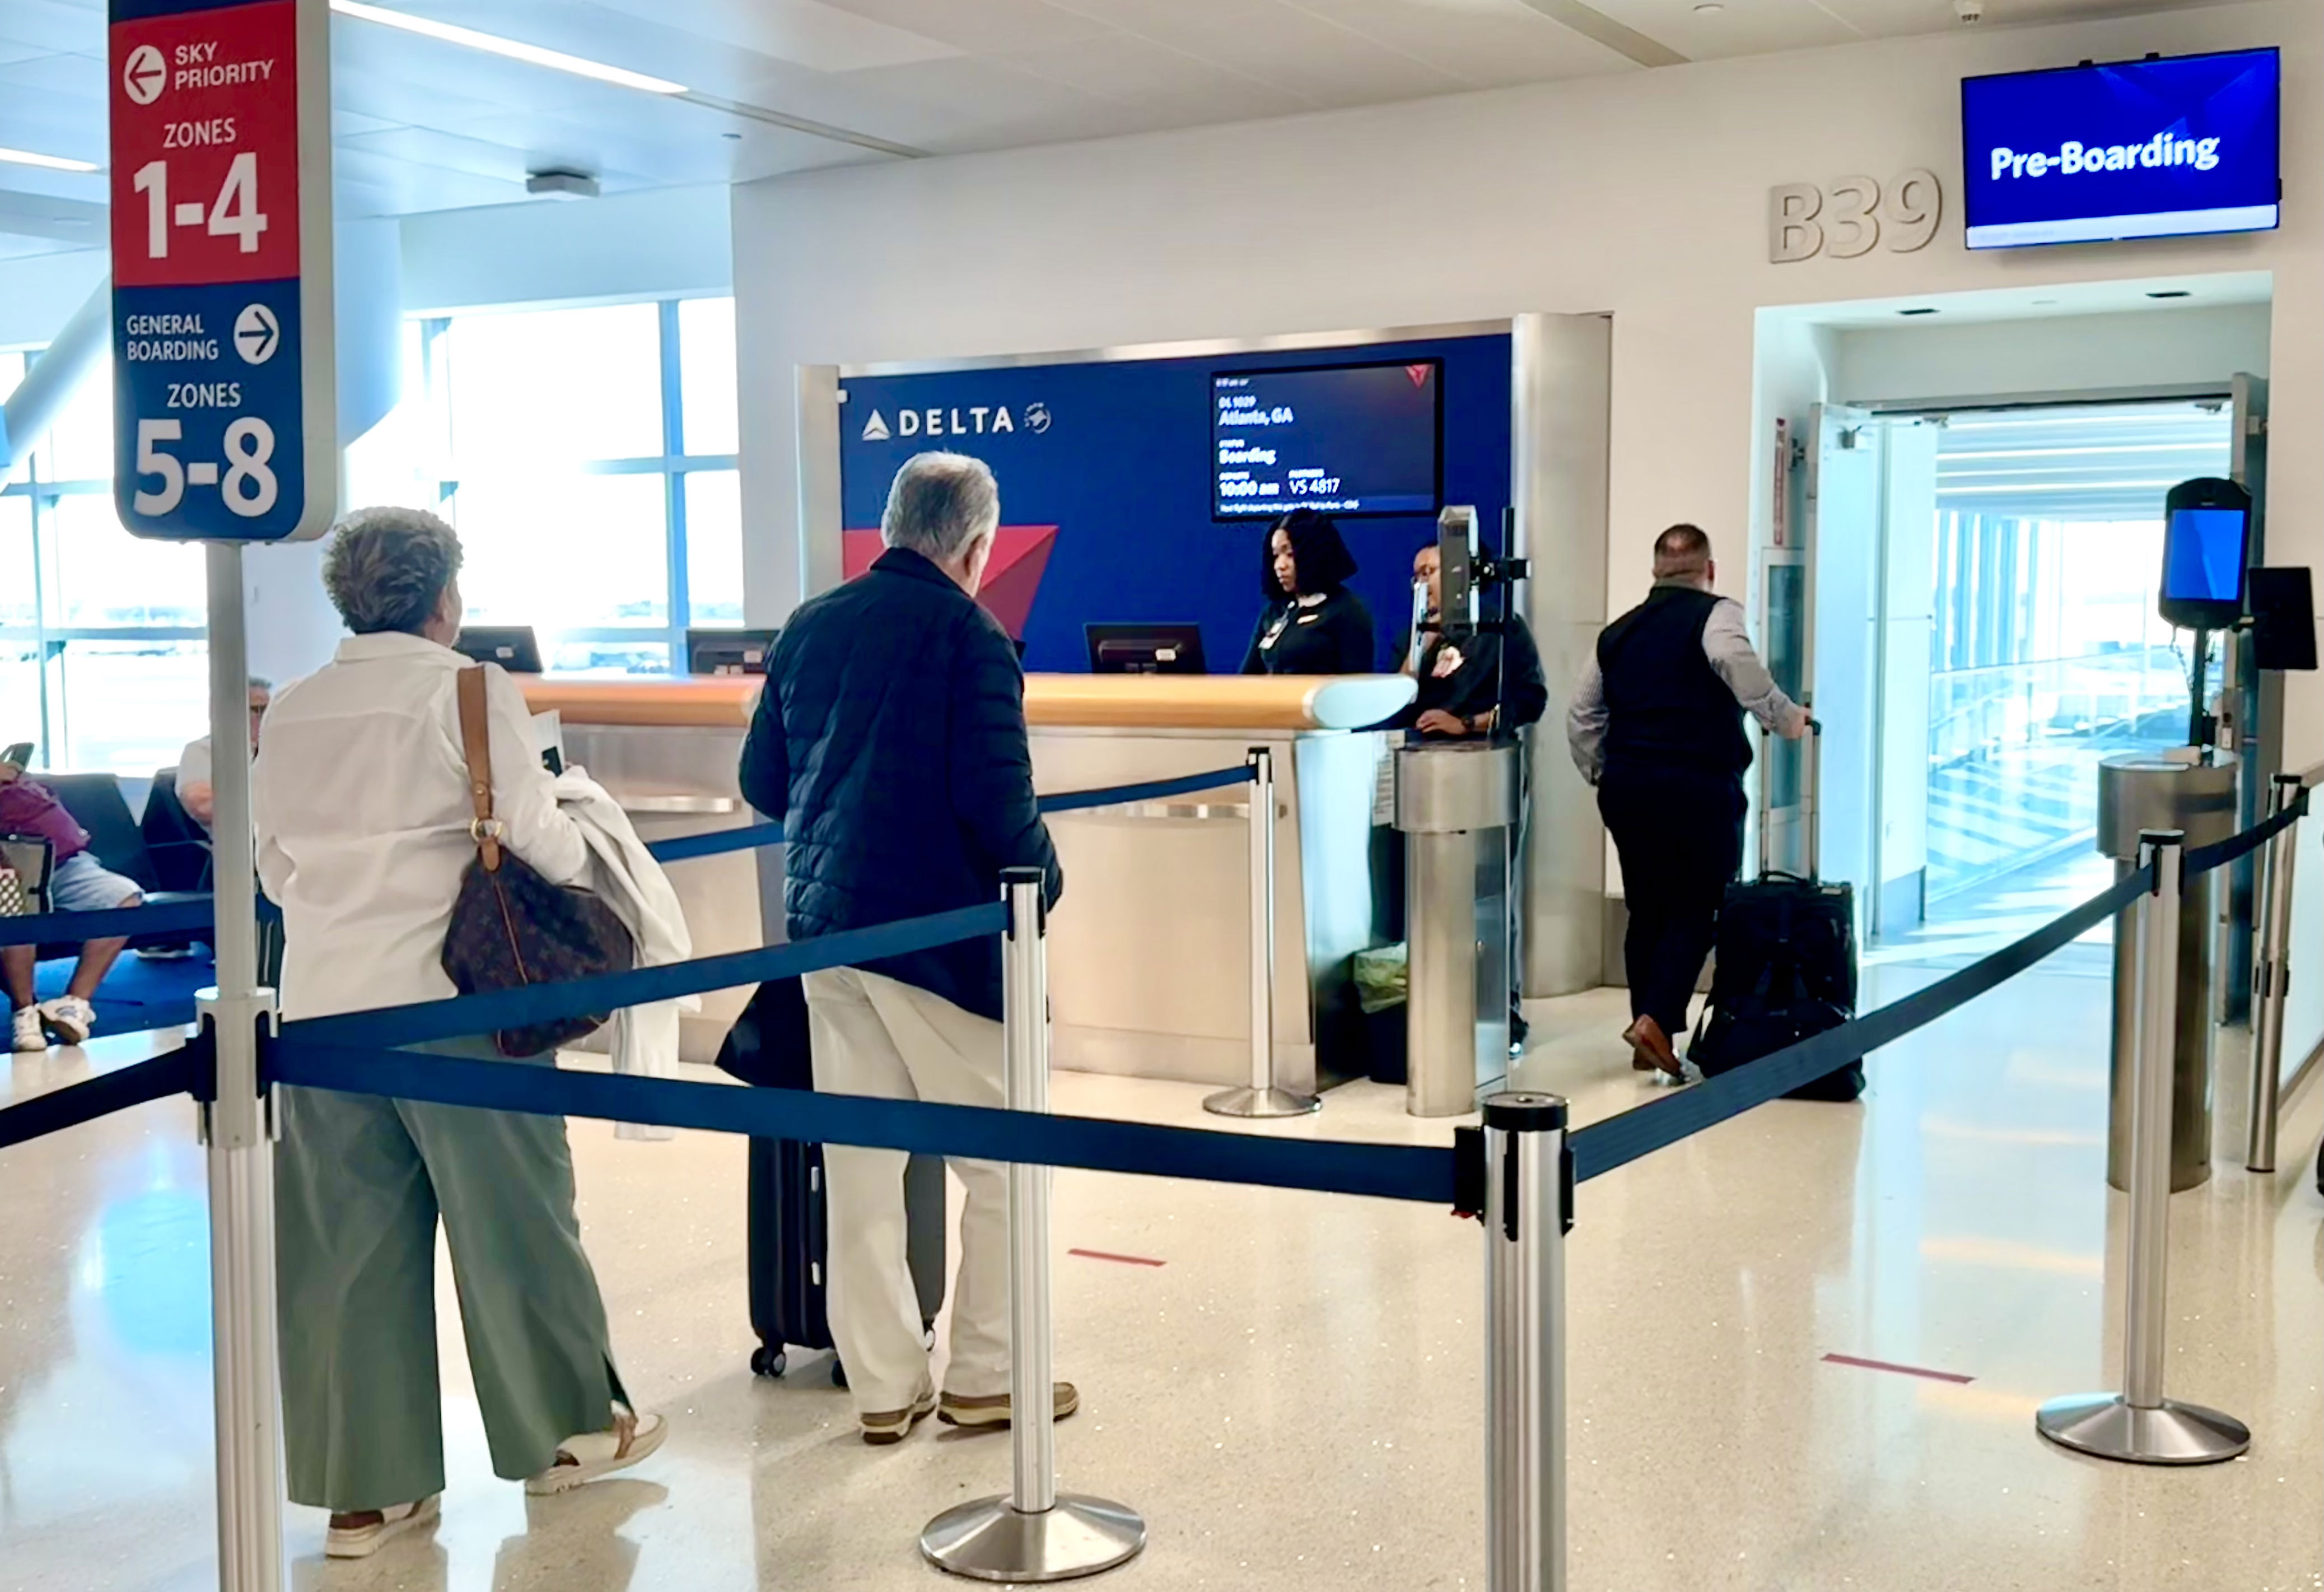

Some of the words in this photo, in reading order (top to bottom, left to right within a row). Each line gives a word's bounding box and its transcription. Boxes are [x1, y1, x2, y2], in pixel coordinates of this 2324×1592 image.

[175, 41, 217, 66] SKY
[175, 59, 274, 90] PRIORITY
[163, 118, 236, 148] ZONES
[1991, 132, 2220, 180] Pre-Boarding
[134, 152, 268, 258] 1-4
[1768, 168, 1943, 264] B39
[127, 314, 204, 335] GENERAL
[127, 339, 218, 360] BOARDING
[167, 383, 241, 408] ZONES
[899, 406, 1014, 436] DELTA
[1219, 409, 1270, 426] Atlanta,
[1271, 407, 1294, 423] GA
[133, 417, 278, 517] 5-8
[1219, 447, 1276, 464] Boarding
[1289, 479, 1308, 495] VS
[1309, 478, 1340, 494] 4817
